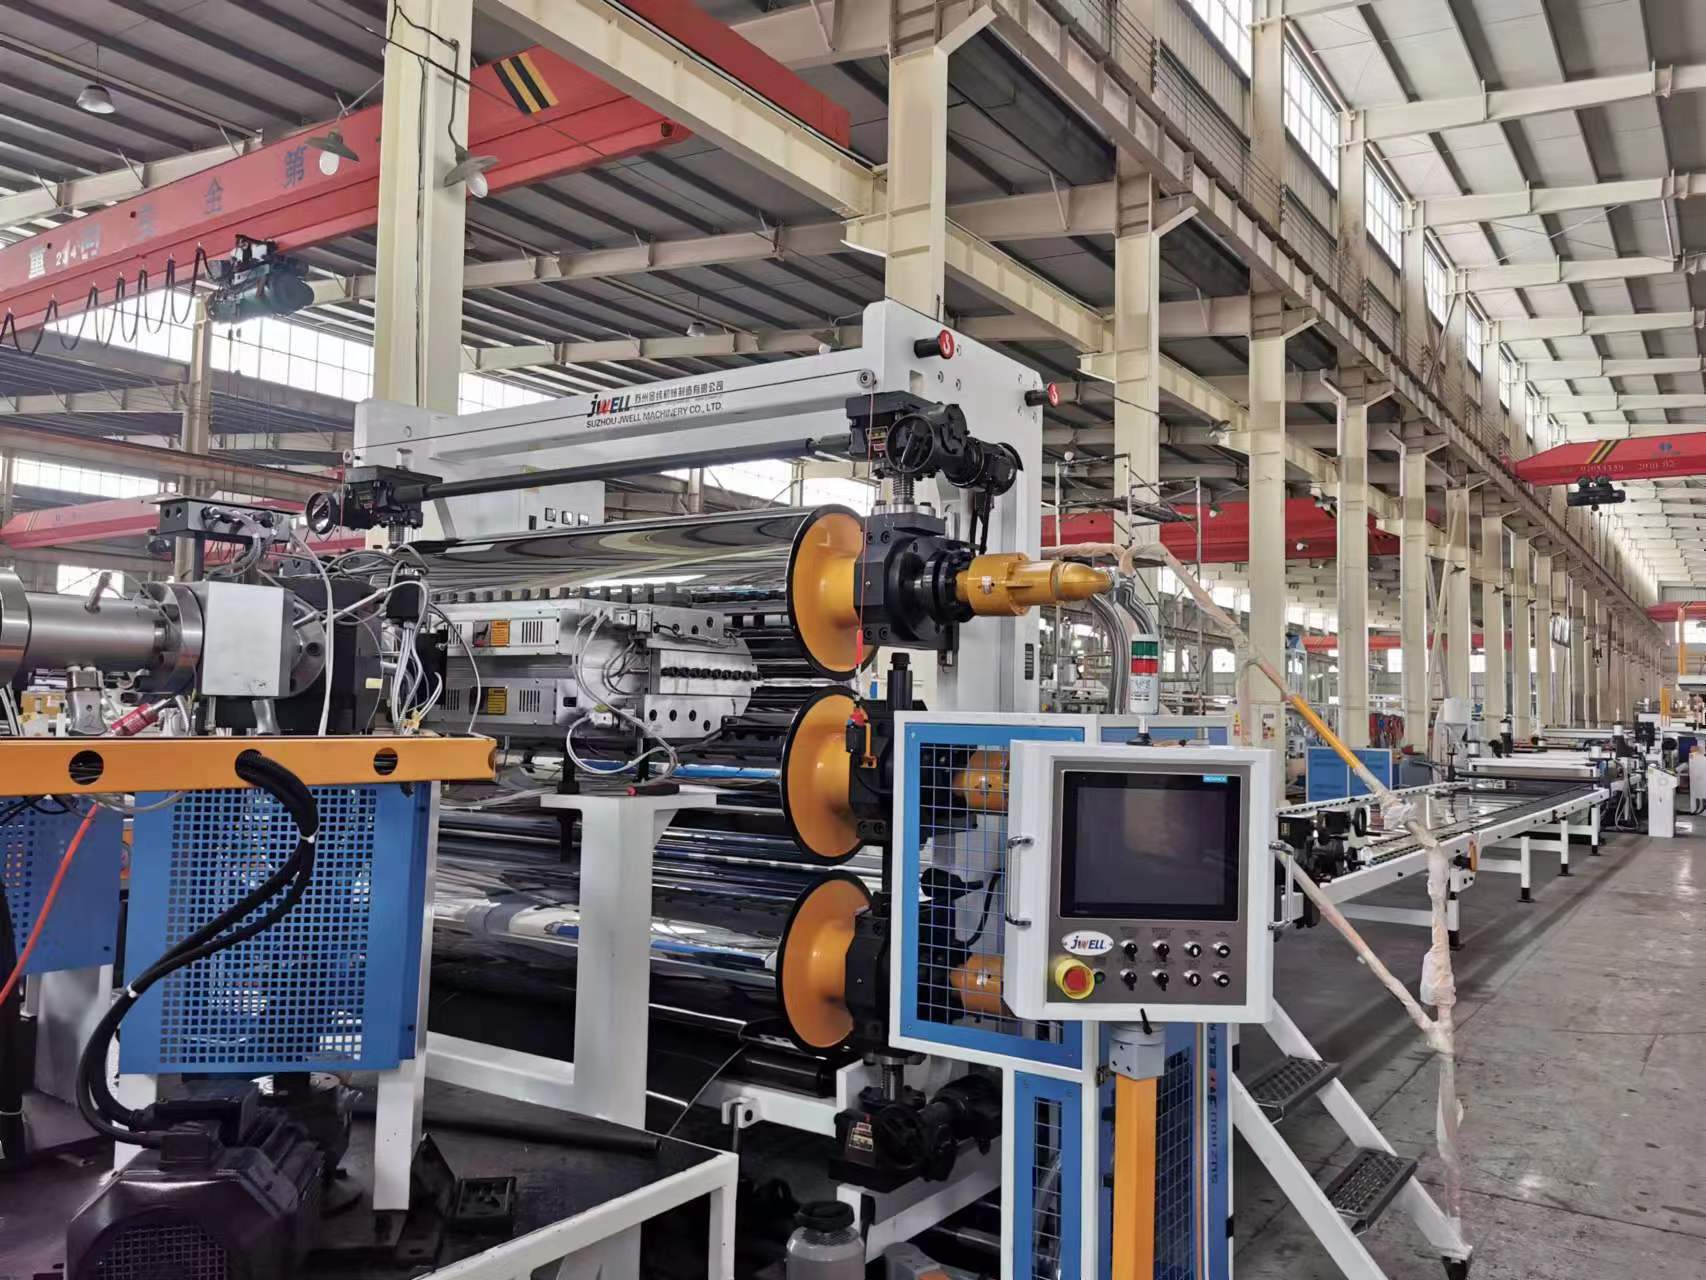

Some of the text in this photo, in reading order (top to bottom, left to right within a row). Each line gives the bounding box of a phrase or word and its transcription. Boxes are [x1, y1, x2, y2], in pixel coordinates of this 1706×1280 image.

[586, 418, 617, 429] SUZHOU
[619, 414, 641, 425] JWELL
[643, 406, 688, 421] MACHINERY
